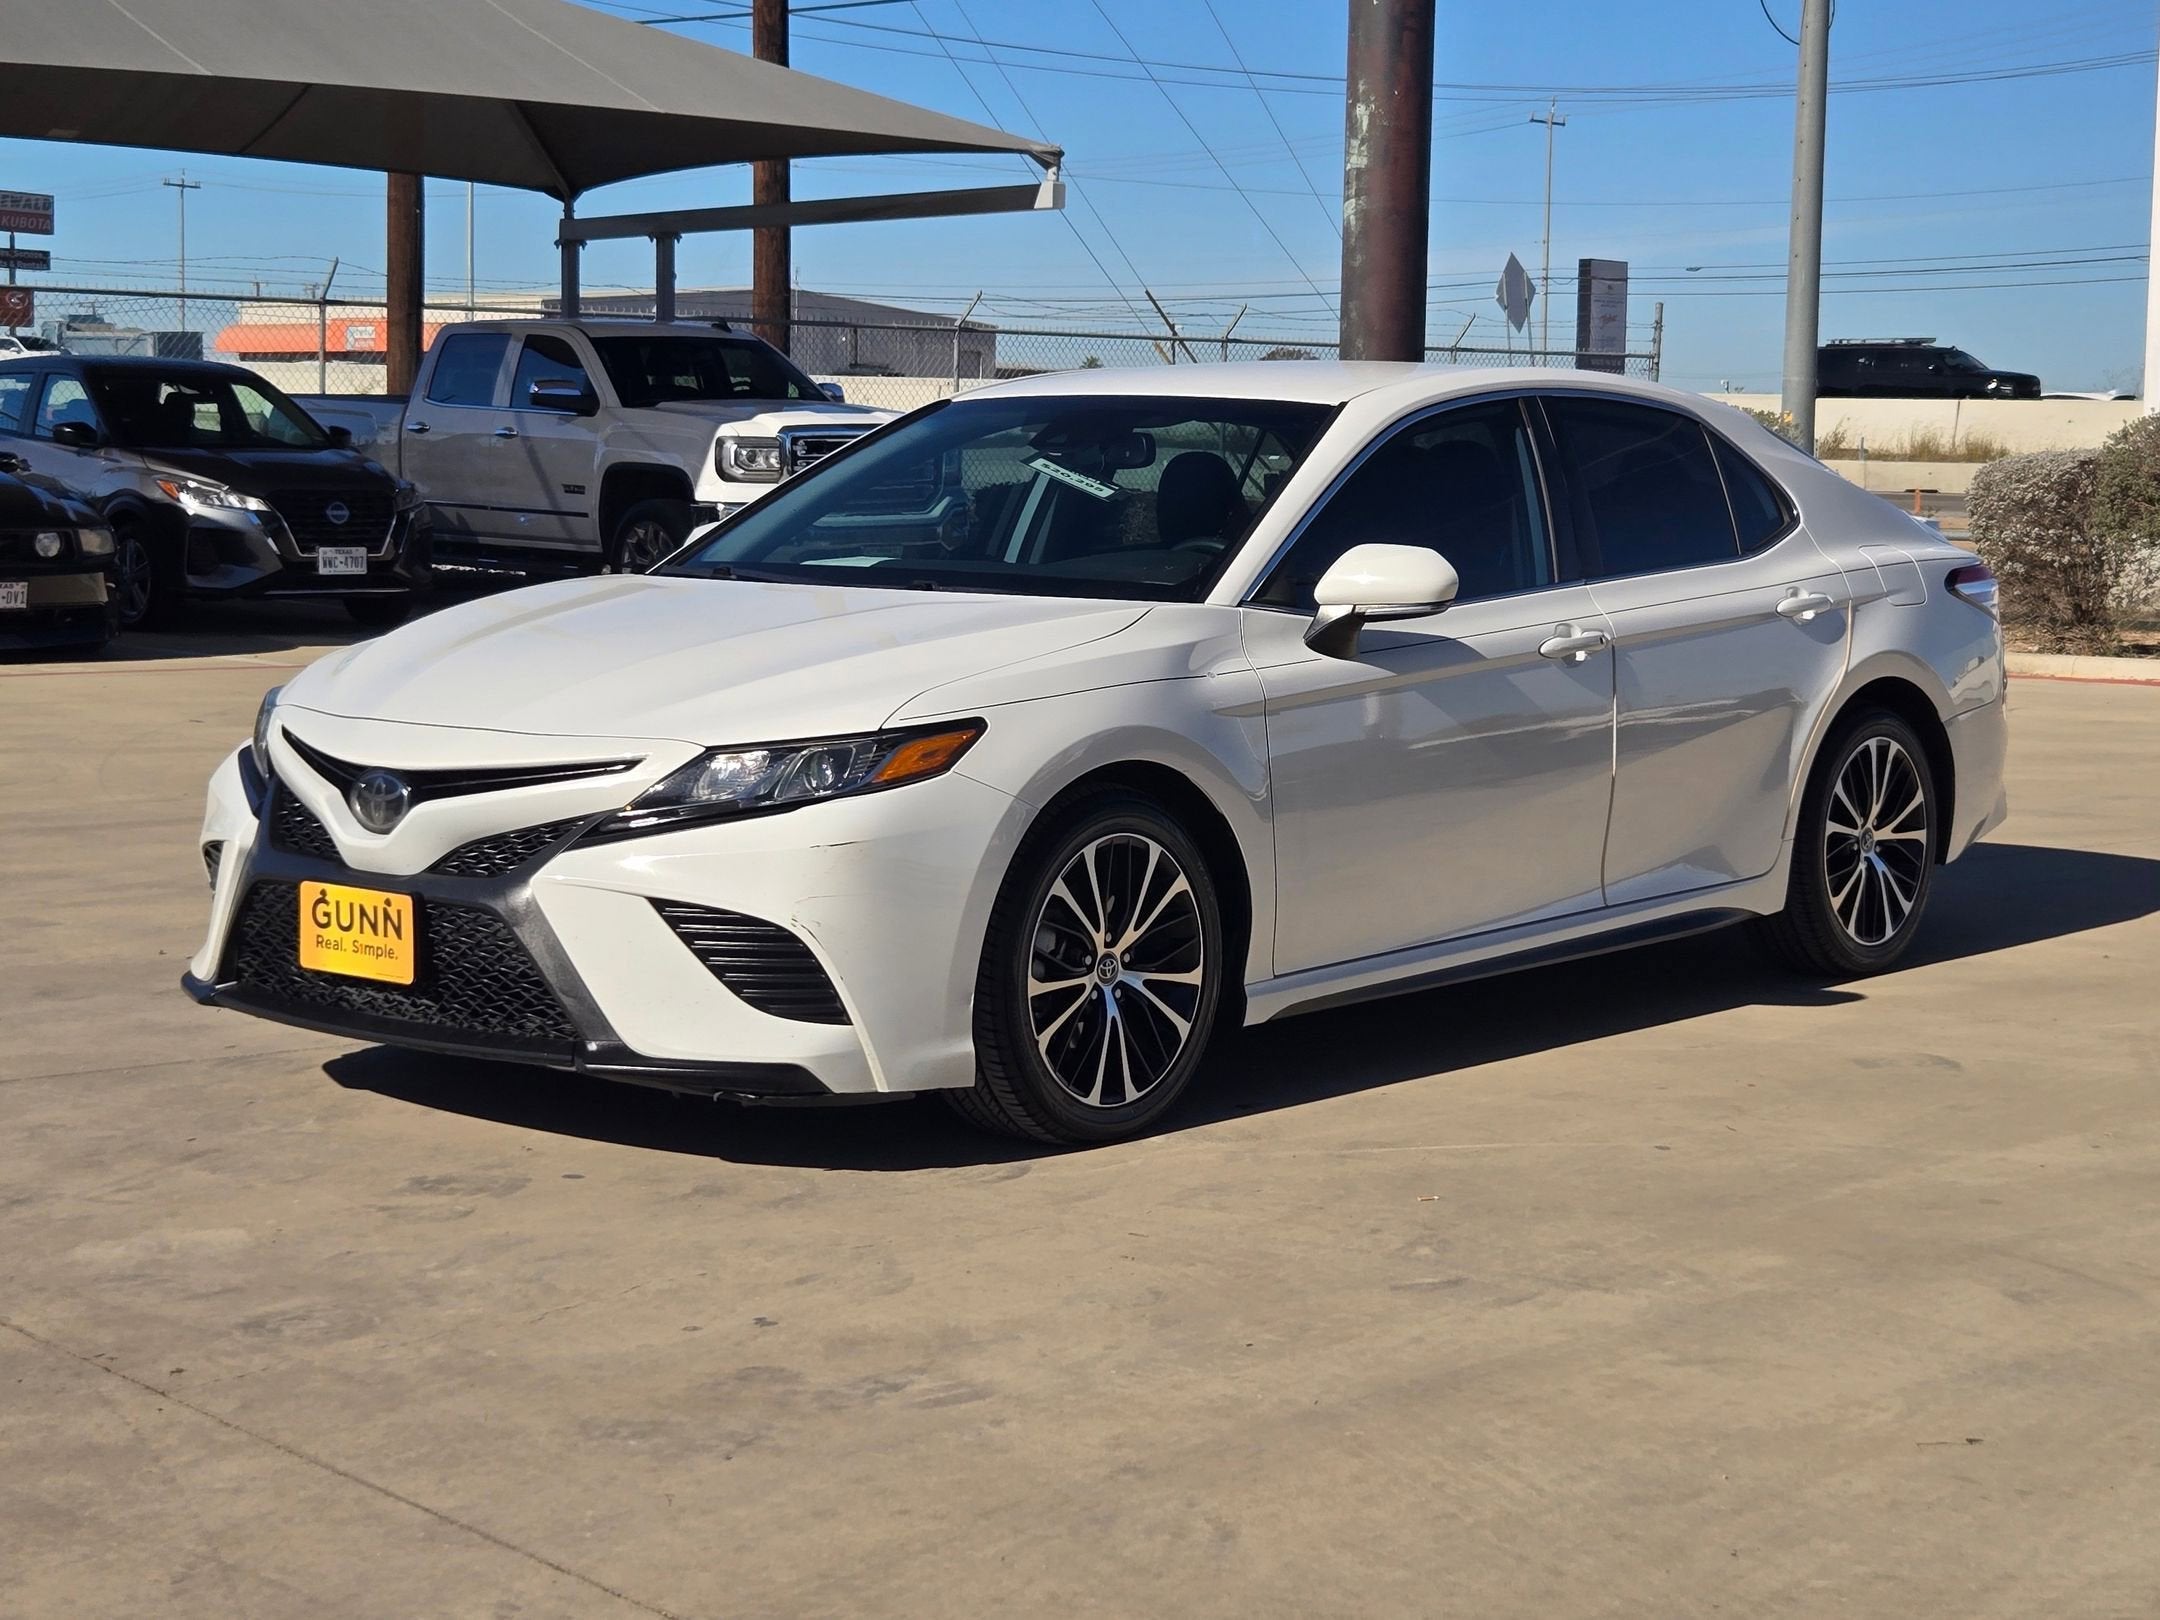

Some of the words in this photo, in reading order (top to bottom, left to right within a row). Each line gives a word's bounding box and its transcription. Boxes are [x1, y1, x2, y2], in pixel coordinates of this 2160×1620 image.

[1, 215, 51, 230] KUBOTA
[311, 888, 403, 940] GUNN
[315, 934, 348, 952] Real.
[351, 939, 399, 960] Simple.
